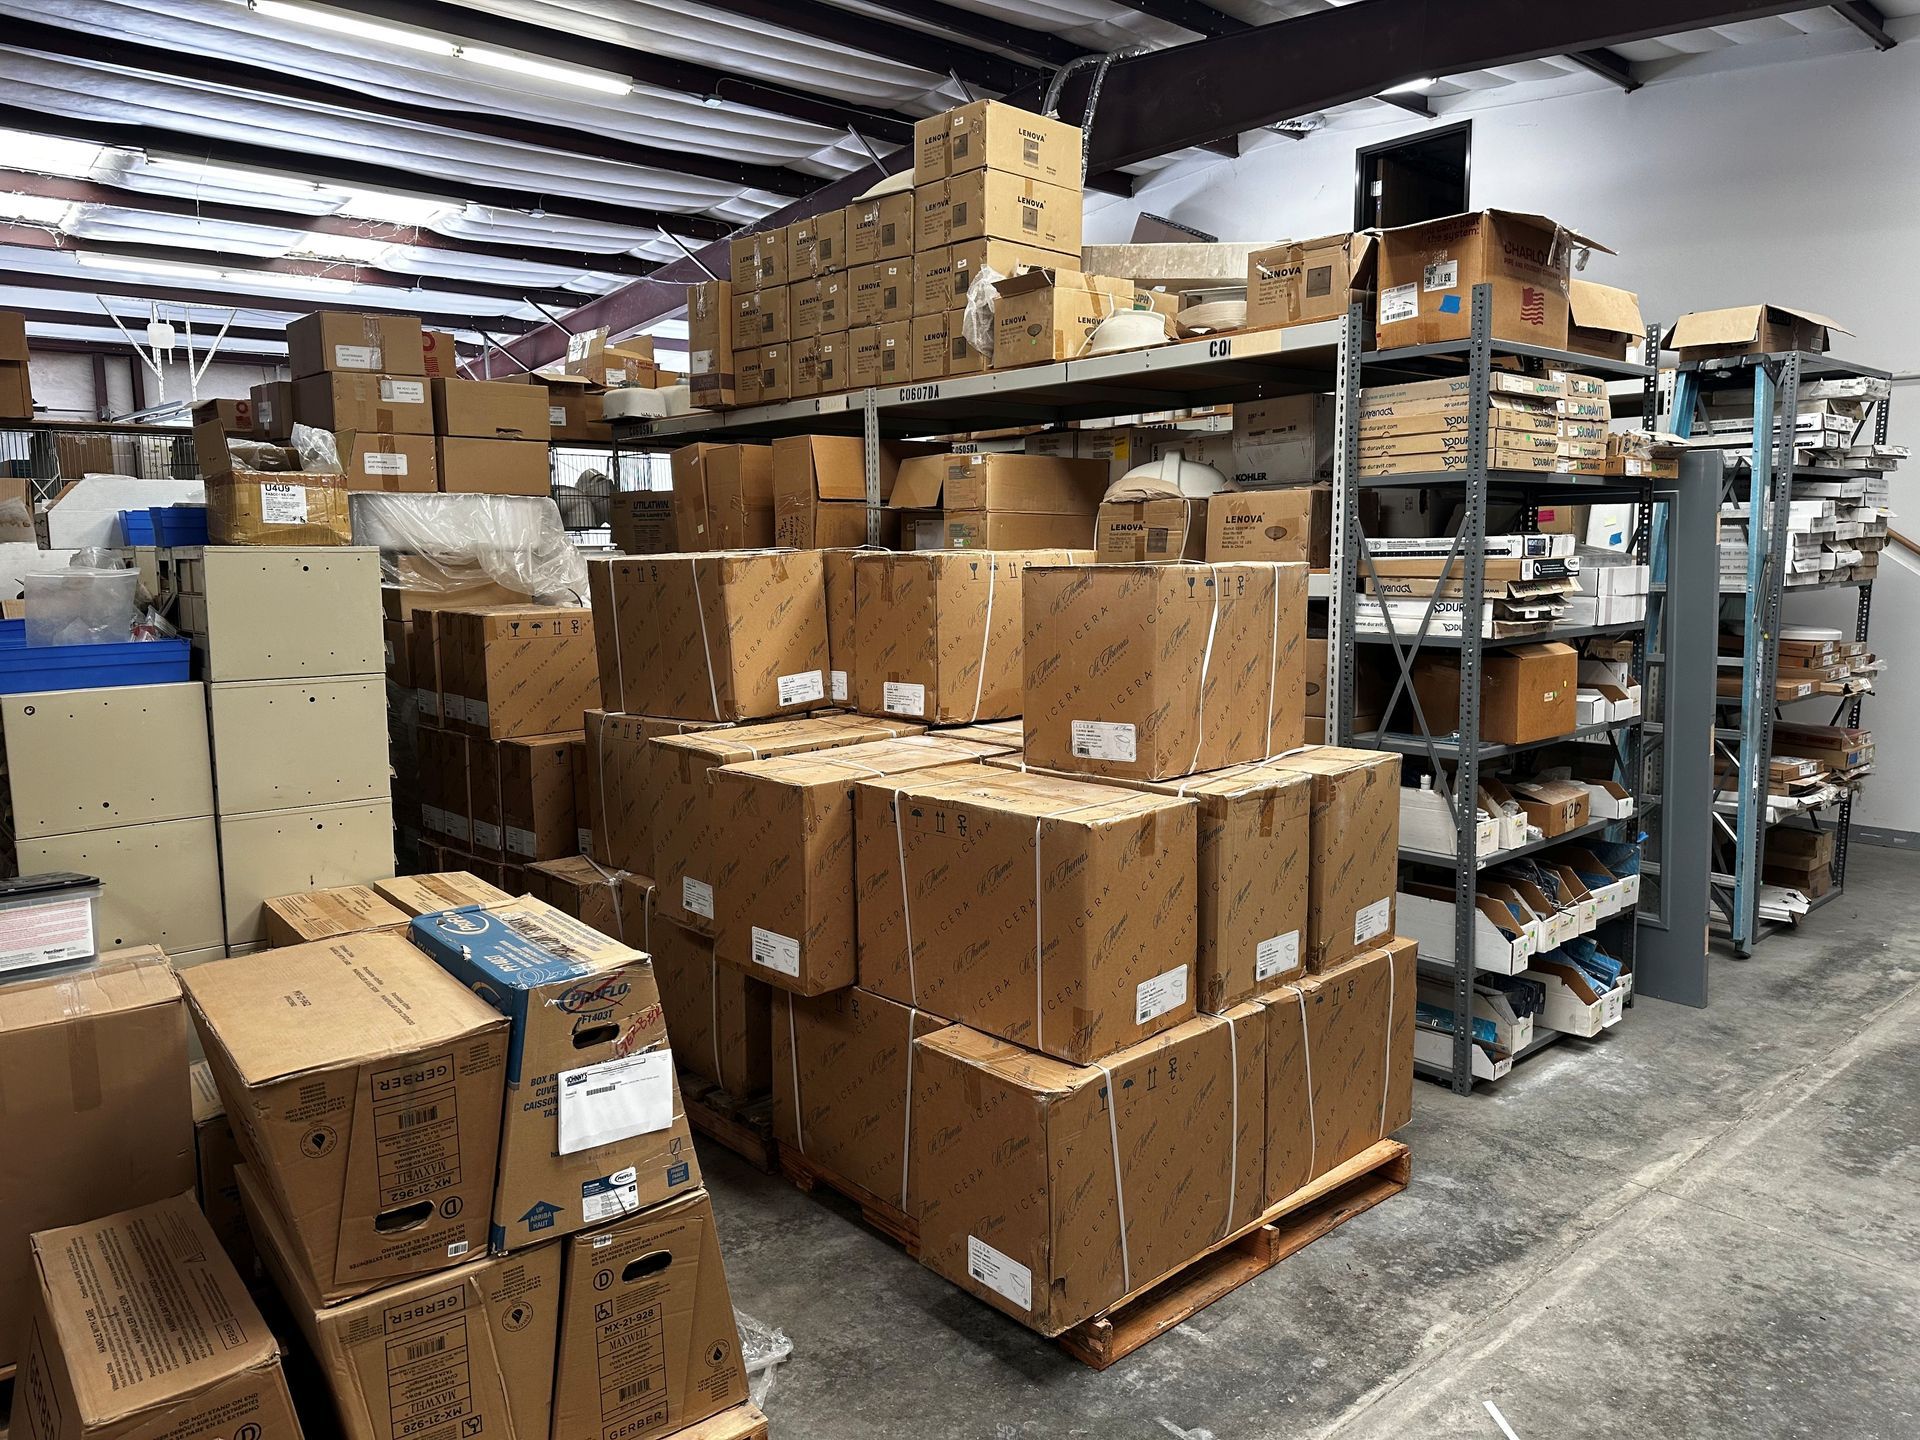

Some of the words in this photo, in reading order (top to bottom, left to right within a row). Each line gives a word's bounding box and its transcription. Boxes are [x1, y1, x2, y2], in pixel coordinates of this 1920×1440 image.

[925, 132, 949, 145] LENOVA
[1018, 128, 1044, 142] LENOVA
[1018, 196, 1044, 210] LENOVA
[1428, 234, 1441, 242] the
[1443, 228, 1480, 242] system:
[858, 282, 880, 291] LENOVA
[1262, 266, 1302, 280] LENOVA
[924, 332, 948, 342] LENOVA
[1002, 315, 1026, 326] LENOVA
[858, 344, 880, 352] LENOVA
[1235, 472, 1267, 482] KOHLER
[1226, 515, 1263, 524] LENOVA
[750, 572, 778, 608] ICERA
[902, 604, 928, 636] ICERA
[1068, 604, 1109, 646] ICERA
[1140, 588, 1176, 632] ICERA
[1263, 607, 1289, 646] ICRA
[784, 618, 810, 653] ICERA
[1100, 636, 1130, 667] Thomas
[1222, 625, 1248, 666] ICERA
[734, 638, 762, 674] ICERA
[1036, 650, 1062, 680] Thomas
[1176, 648, 1205, 692] ICERA
[1045, 684, 1082, 722] ICERA
[1110, 669, 1152, 710] ICERA
[1246, 682, 1272, 721] ICERA
[1206, 704, 1230, 746] ICERA
[796, 804, 832, 848] ICERA
[1360, 800, 1384, 842] ICERA
[956, 820, 992, 859] ICERA
[1258, 821, 1287, 870] ICERA
[1312, 829, 1344, 870] ICERA
[1057, 850, 1088, 882] Thomas
[1136, 848, 1169, 901] ICERA
[1206, 852, 1240, 897] ICERA
[1069, 884, 1110, 934] ICERA
[1162, 874, 1185, 914] Thomas
[1284, 876, 1310, 920] ICERA
[1342, 877, 1365, 922] ICERA
[934, 902, 970, 937] ICERA
[998, 898, 1037, 935] ICERA
[1104, 912, 1129, 952] Thomas
[1169, 904, 1199, 956] ICERA
[1236, 906, 1265, 956] ICERA
[814, 939, 850, 990] ICERA
[1112, 942, 1146, 998] ICERA
[972, 978, 1011, 1014] ICERA
[1042, 978, 1083, 1015] ICERA
[615, 1006, 662, 1056] GERBER
[380, 1066, 447, 1091] GERBER
[531, 1075, 547, 1087] BOX
[1165, 1048, 1200, 1104] ICERA
[1354, 1070, 1378, 1116] ICERA
[970, 1090, 1008, 1122] ICERA
[1200, 1100, 1233, 1154] ICERA
[392, 1176, 451, 1202] MX-21-962
[394, 1161, 447, 1185] MAXWELL
[950, 1168, 984, 1198] ICERA
[1141, 1146, 1176, 1203] ICERA
[1234, 1146, 1265, 1200] ICERA
[444, 1200, 457, 1214] D
[530, 1212, 552, 1223] ARRIBA
[533, 1220, 549, 1230] HAUT
[1178, 1192, 1212, 1249] ICERA
[1077, 1196, 1114, 1258] ICERA
[599, 1272, 609, 1287] D
[392, 1296, 458, 1324] GERBER
[604, 1308, 654, 1334] MX-21-928
[610, 1328, 649, 1351] MAXWELL
[191, 1412, 206, 1422] NOT
[208, 1404, 230, 1416] STAND
[244, 1392, 258, 1403] END
[227, 1404, 260, 1422] EXTREMO
[409, 1388, 456, 1414] MAXWELL
[170, 1424, 195, 1437] DEBOUT
[404, 1406, 462, 1434] MX-21-928
[609, 1412, 663, 1440] GERBER
